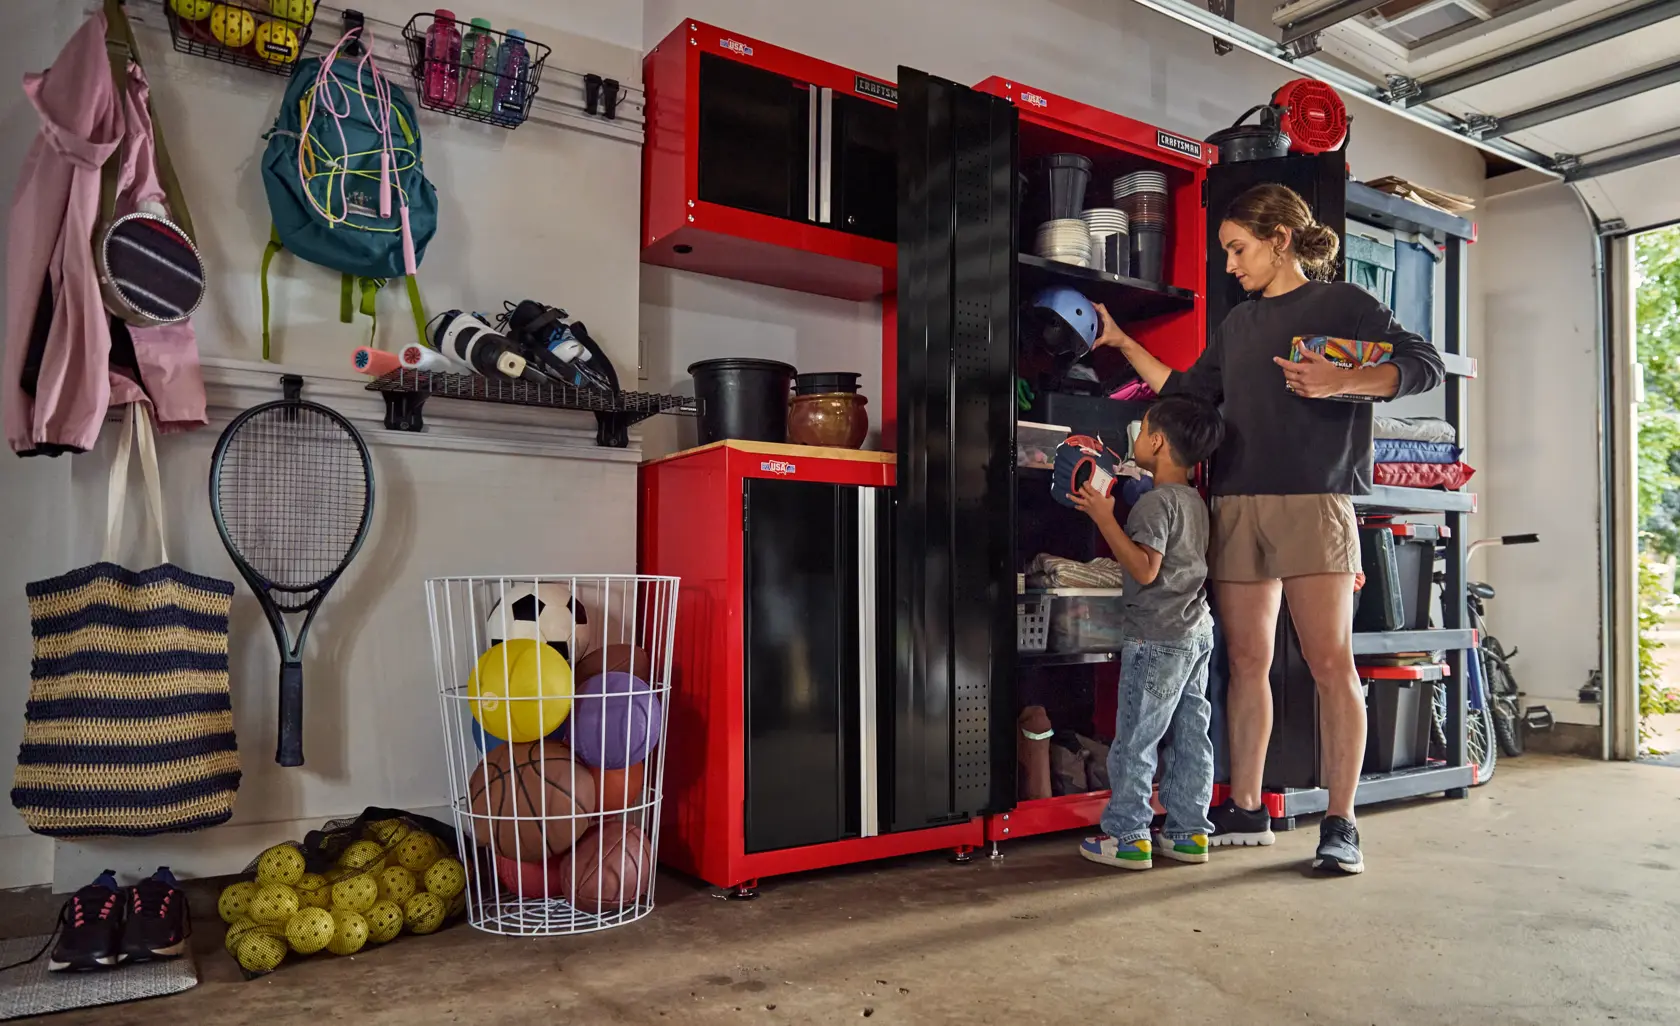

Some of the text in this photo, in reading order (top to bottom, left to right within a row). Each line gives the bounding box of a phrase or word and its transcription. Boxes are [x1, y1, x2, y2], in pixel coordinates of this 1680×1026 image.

[730, 41, 744, 52] USA
[860, 80, 898, 99] CRAFTSM
[1161, 135, 1199, 154] CRAFTSMAN
[770, 462, 786, 471] USA
